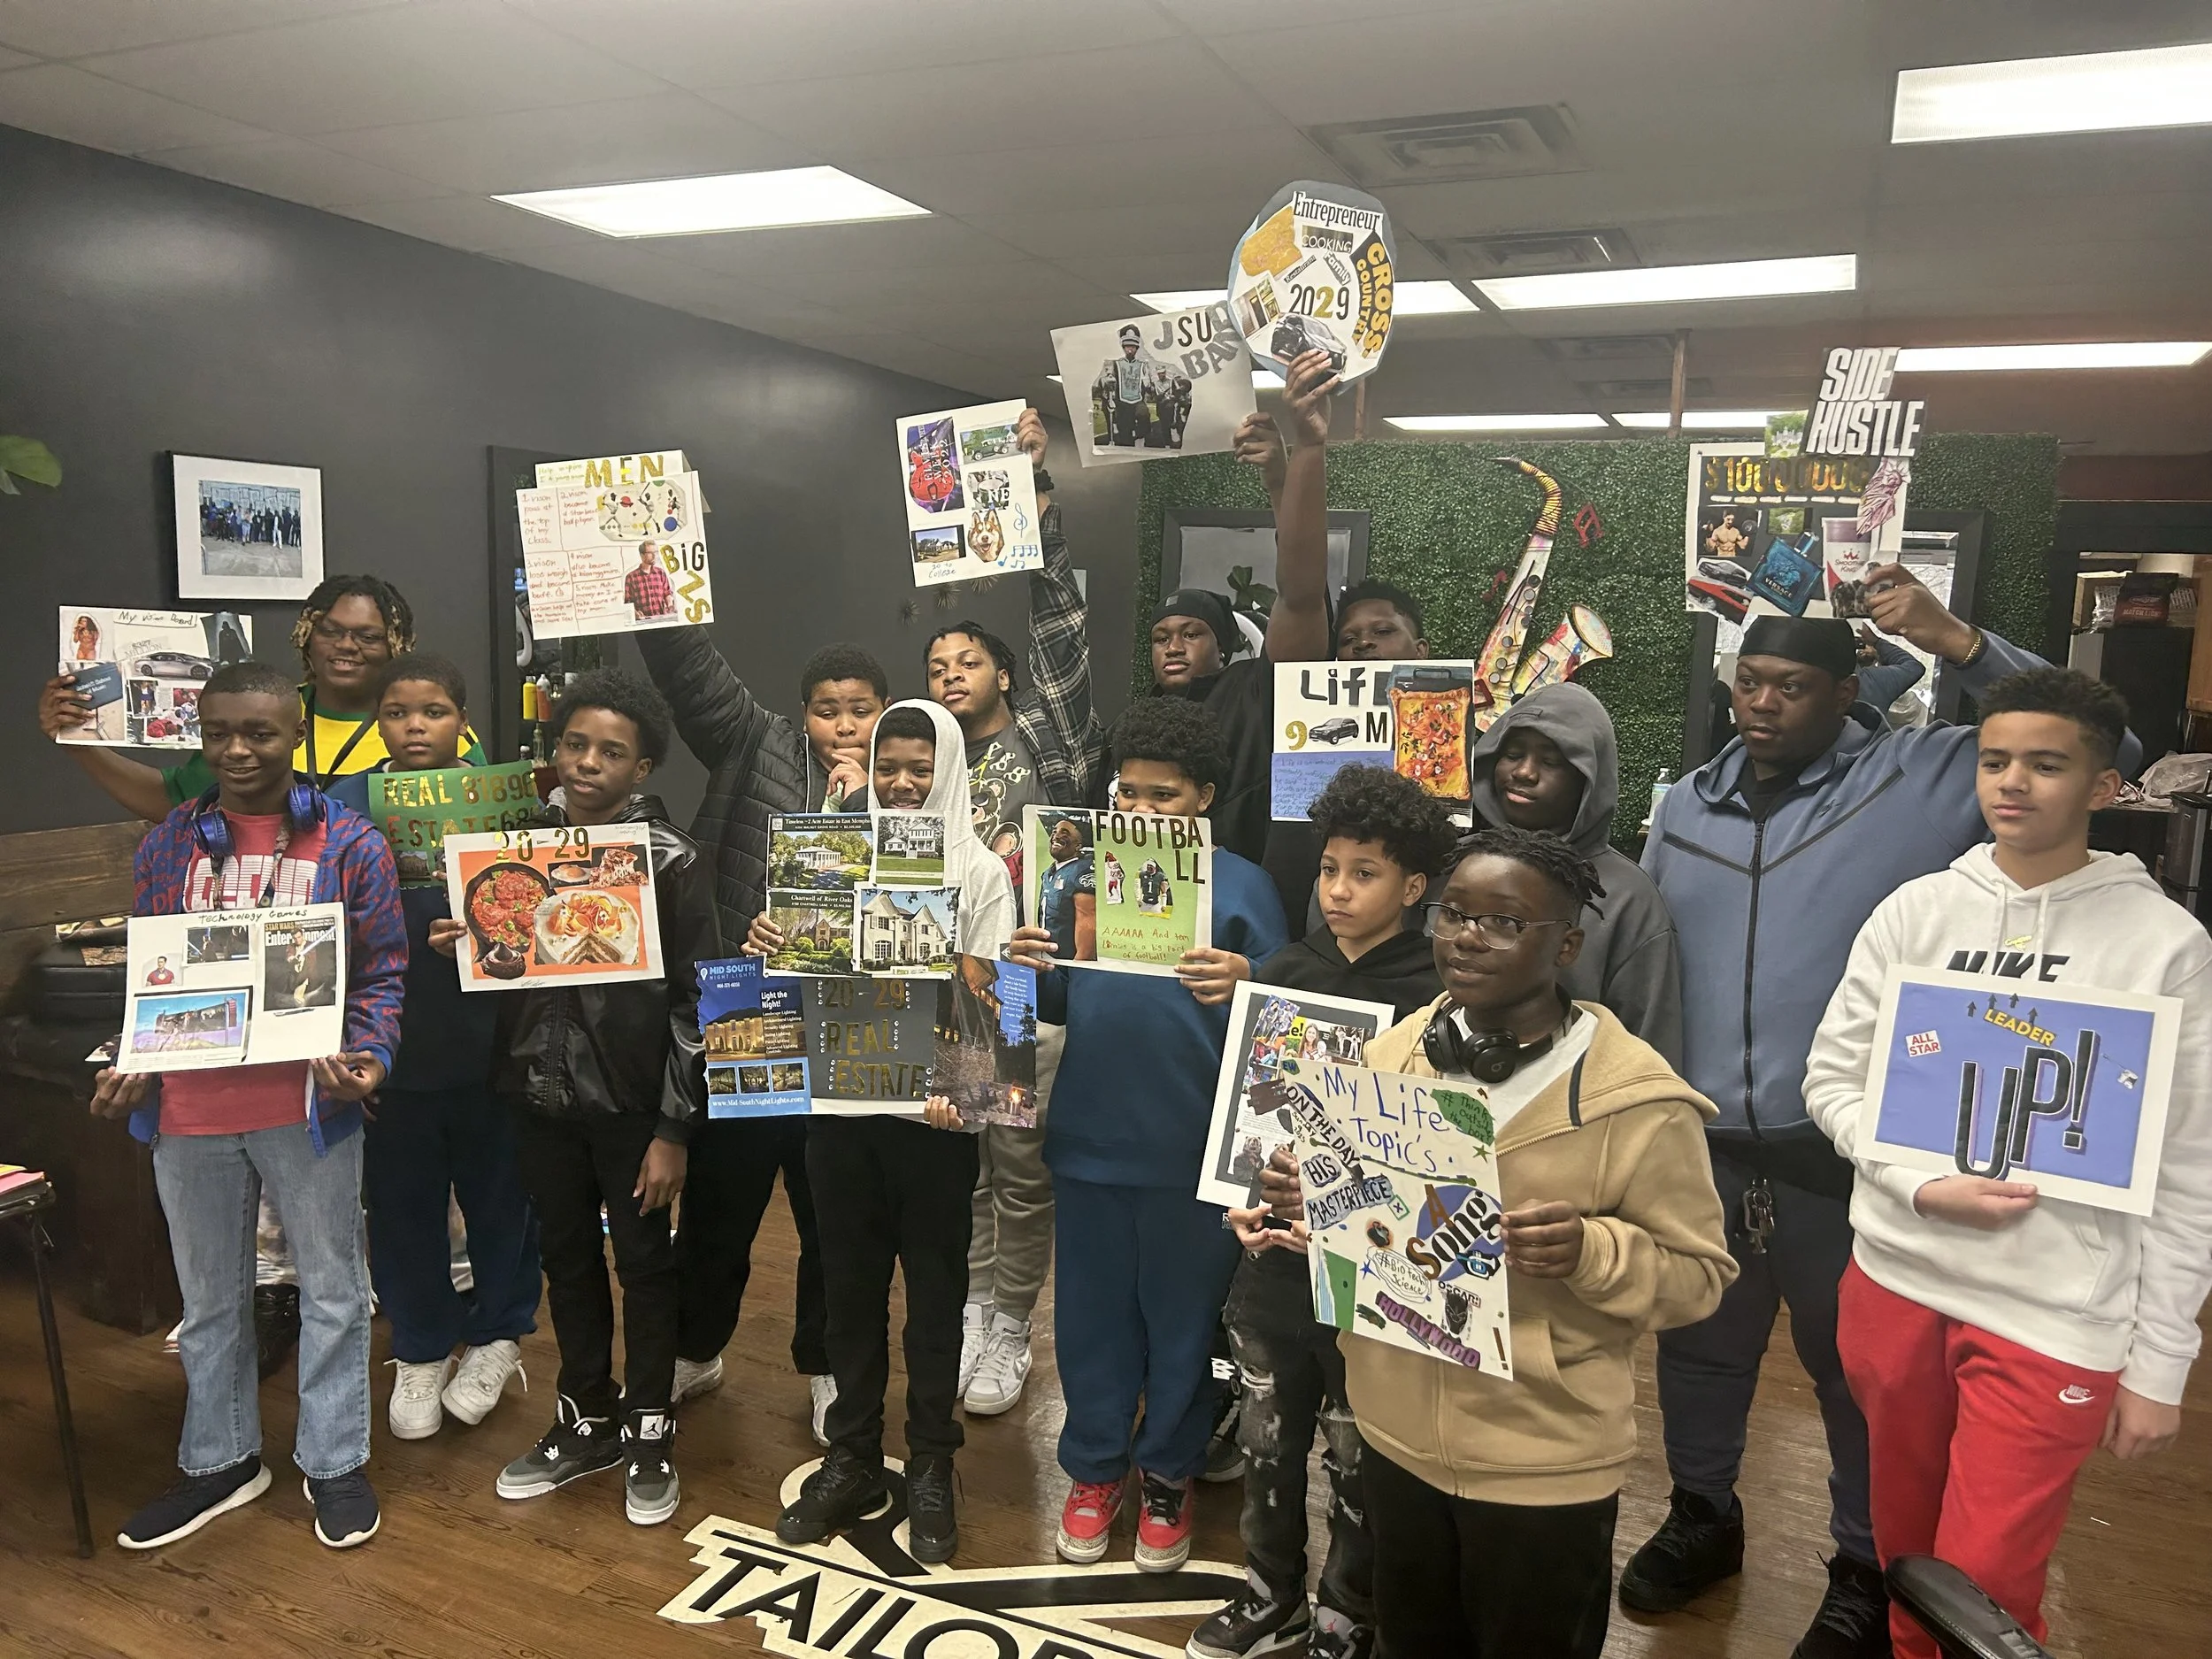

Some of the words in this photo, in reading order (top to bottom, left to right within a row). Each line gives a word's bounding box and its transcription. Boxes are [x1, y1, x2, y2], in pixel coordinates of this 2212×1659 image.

[1294, 191, 1380, 231] Entrepreneur
[1302, 234, 1352, 252] COOKING
[1324, 251, 1351, 285] Family
[1289, 284, 1350, 320] 2029
[1352, 258, 1372, 345] COUNTRY
[1363, 242, 1394, 353] CROSS
[1153, 310, 1212, 350] JSU
[1819, 348, 1898, 402] SIDE
[1806, 400, 1924, 457] HUSTLE
[585, 455, 664, 488] MEN
[119, 611, 137, 625] My
[1286, 720, 1308, 750] 9
[1366, 712, 1387, 743] M
[384, 774, 454, 808] REAL
[1096, 810, 1204, 849] FOOTBA
[1175, 850, 1206, 885] LL
[1152, 928, 1169, 939] And
[710, 965, 725, 974] MID
[726, 964, 756, 973] SOUTH
[761, 992, 777, 1002] Light
[826, 1019, 895, 1056] REAL
[1911, 1033, 1934, 1047] ALL
[1984, 1009, 2055, 1047] LEADER
[1909, 1044, 1940, 1056] STAR
[835, 1059, 926, 1097] ESTATE
[1323, 1066, 1357, 1111] My
[1372, 1071, 1450, 1132] Life
[1954, 1029, 2101, 1180] UP!
[1286, 1086, 1310, 1112] ON
[1309, 1106, 1337, 1142] THE
[1330, 1134, 1361, 1168] DAY
[1305, 1157, 1340, 1182] HIS
[1307, 1179, 1393, 1225] MASTERPIECE
[1391, 1274, 1424, 1295] Science
[1378, 1294, 1481, 1369] HOLLYWOOD
[2066, 1384, 2091, 1399] NIKE
